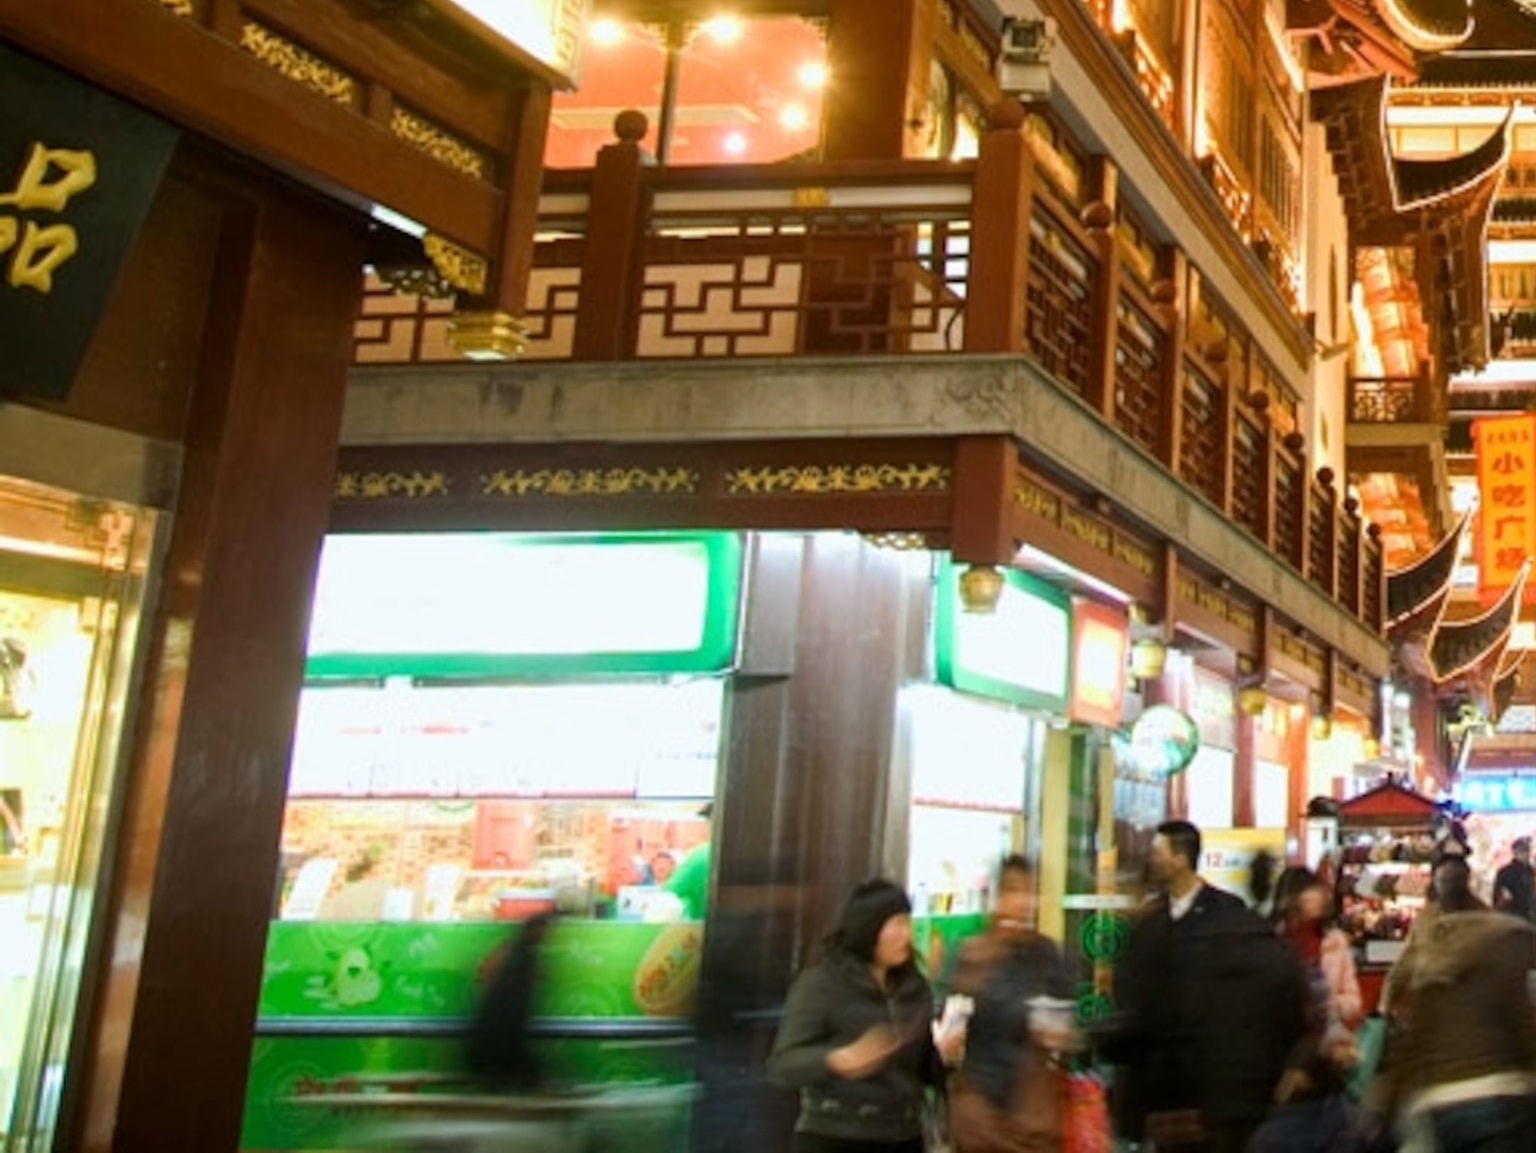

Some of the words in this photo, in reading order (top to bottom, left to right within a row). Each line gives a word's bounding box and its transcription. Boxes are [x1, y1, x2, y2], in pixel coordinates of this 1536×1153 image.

[0, 141, 96, 293] 品
[1491, 451, 1526, 569] 小吃广场
